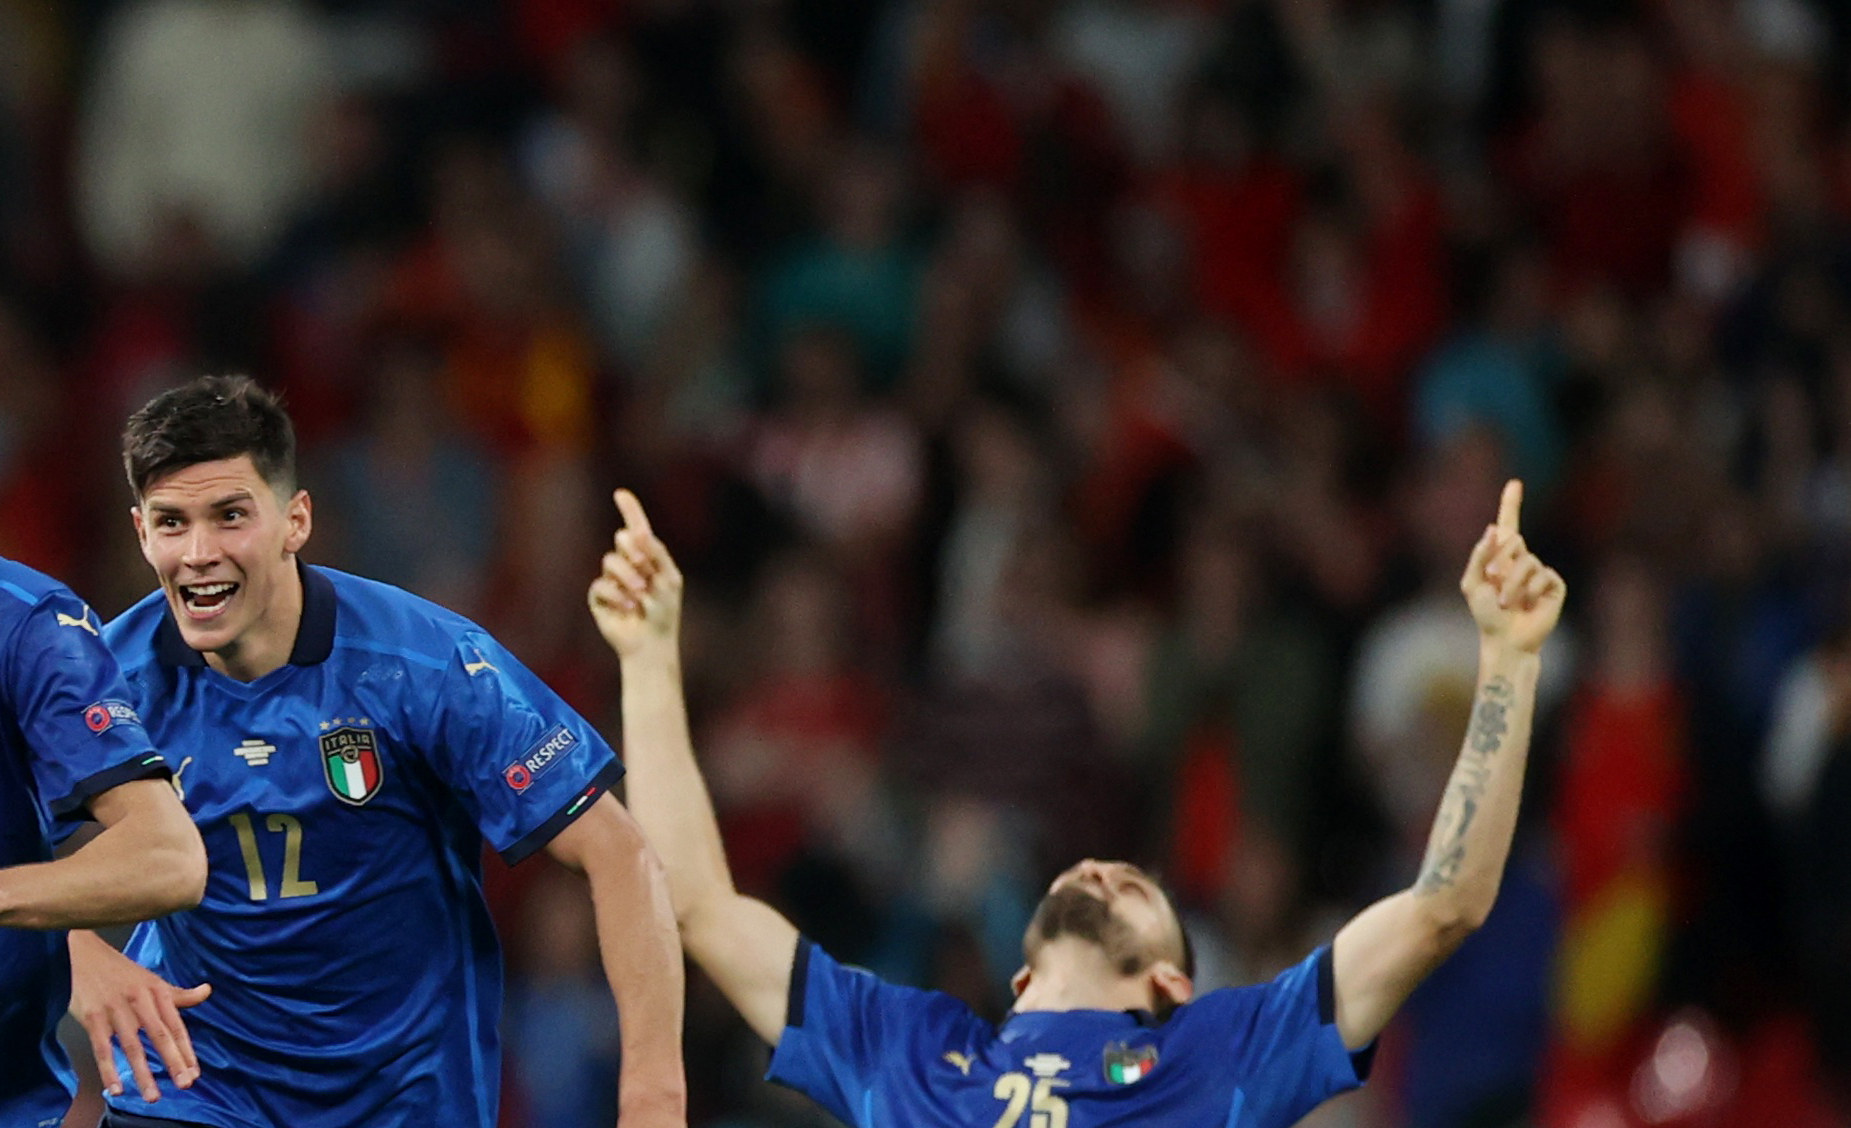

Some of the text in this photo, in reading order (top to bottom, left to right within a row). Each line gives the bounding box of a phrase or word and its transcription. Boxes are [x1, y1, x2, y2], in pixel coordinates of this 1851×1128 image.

[107, 705, 142, 724] RESP
[325, 734, 370, 750] ITALIA
[525, 728, 574, 773] RESPECT
[228, 813, 319, 901] 12
